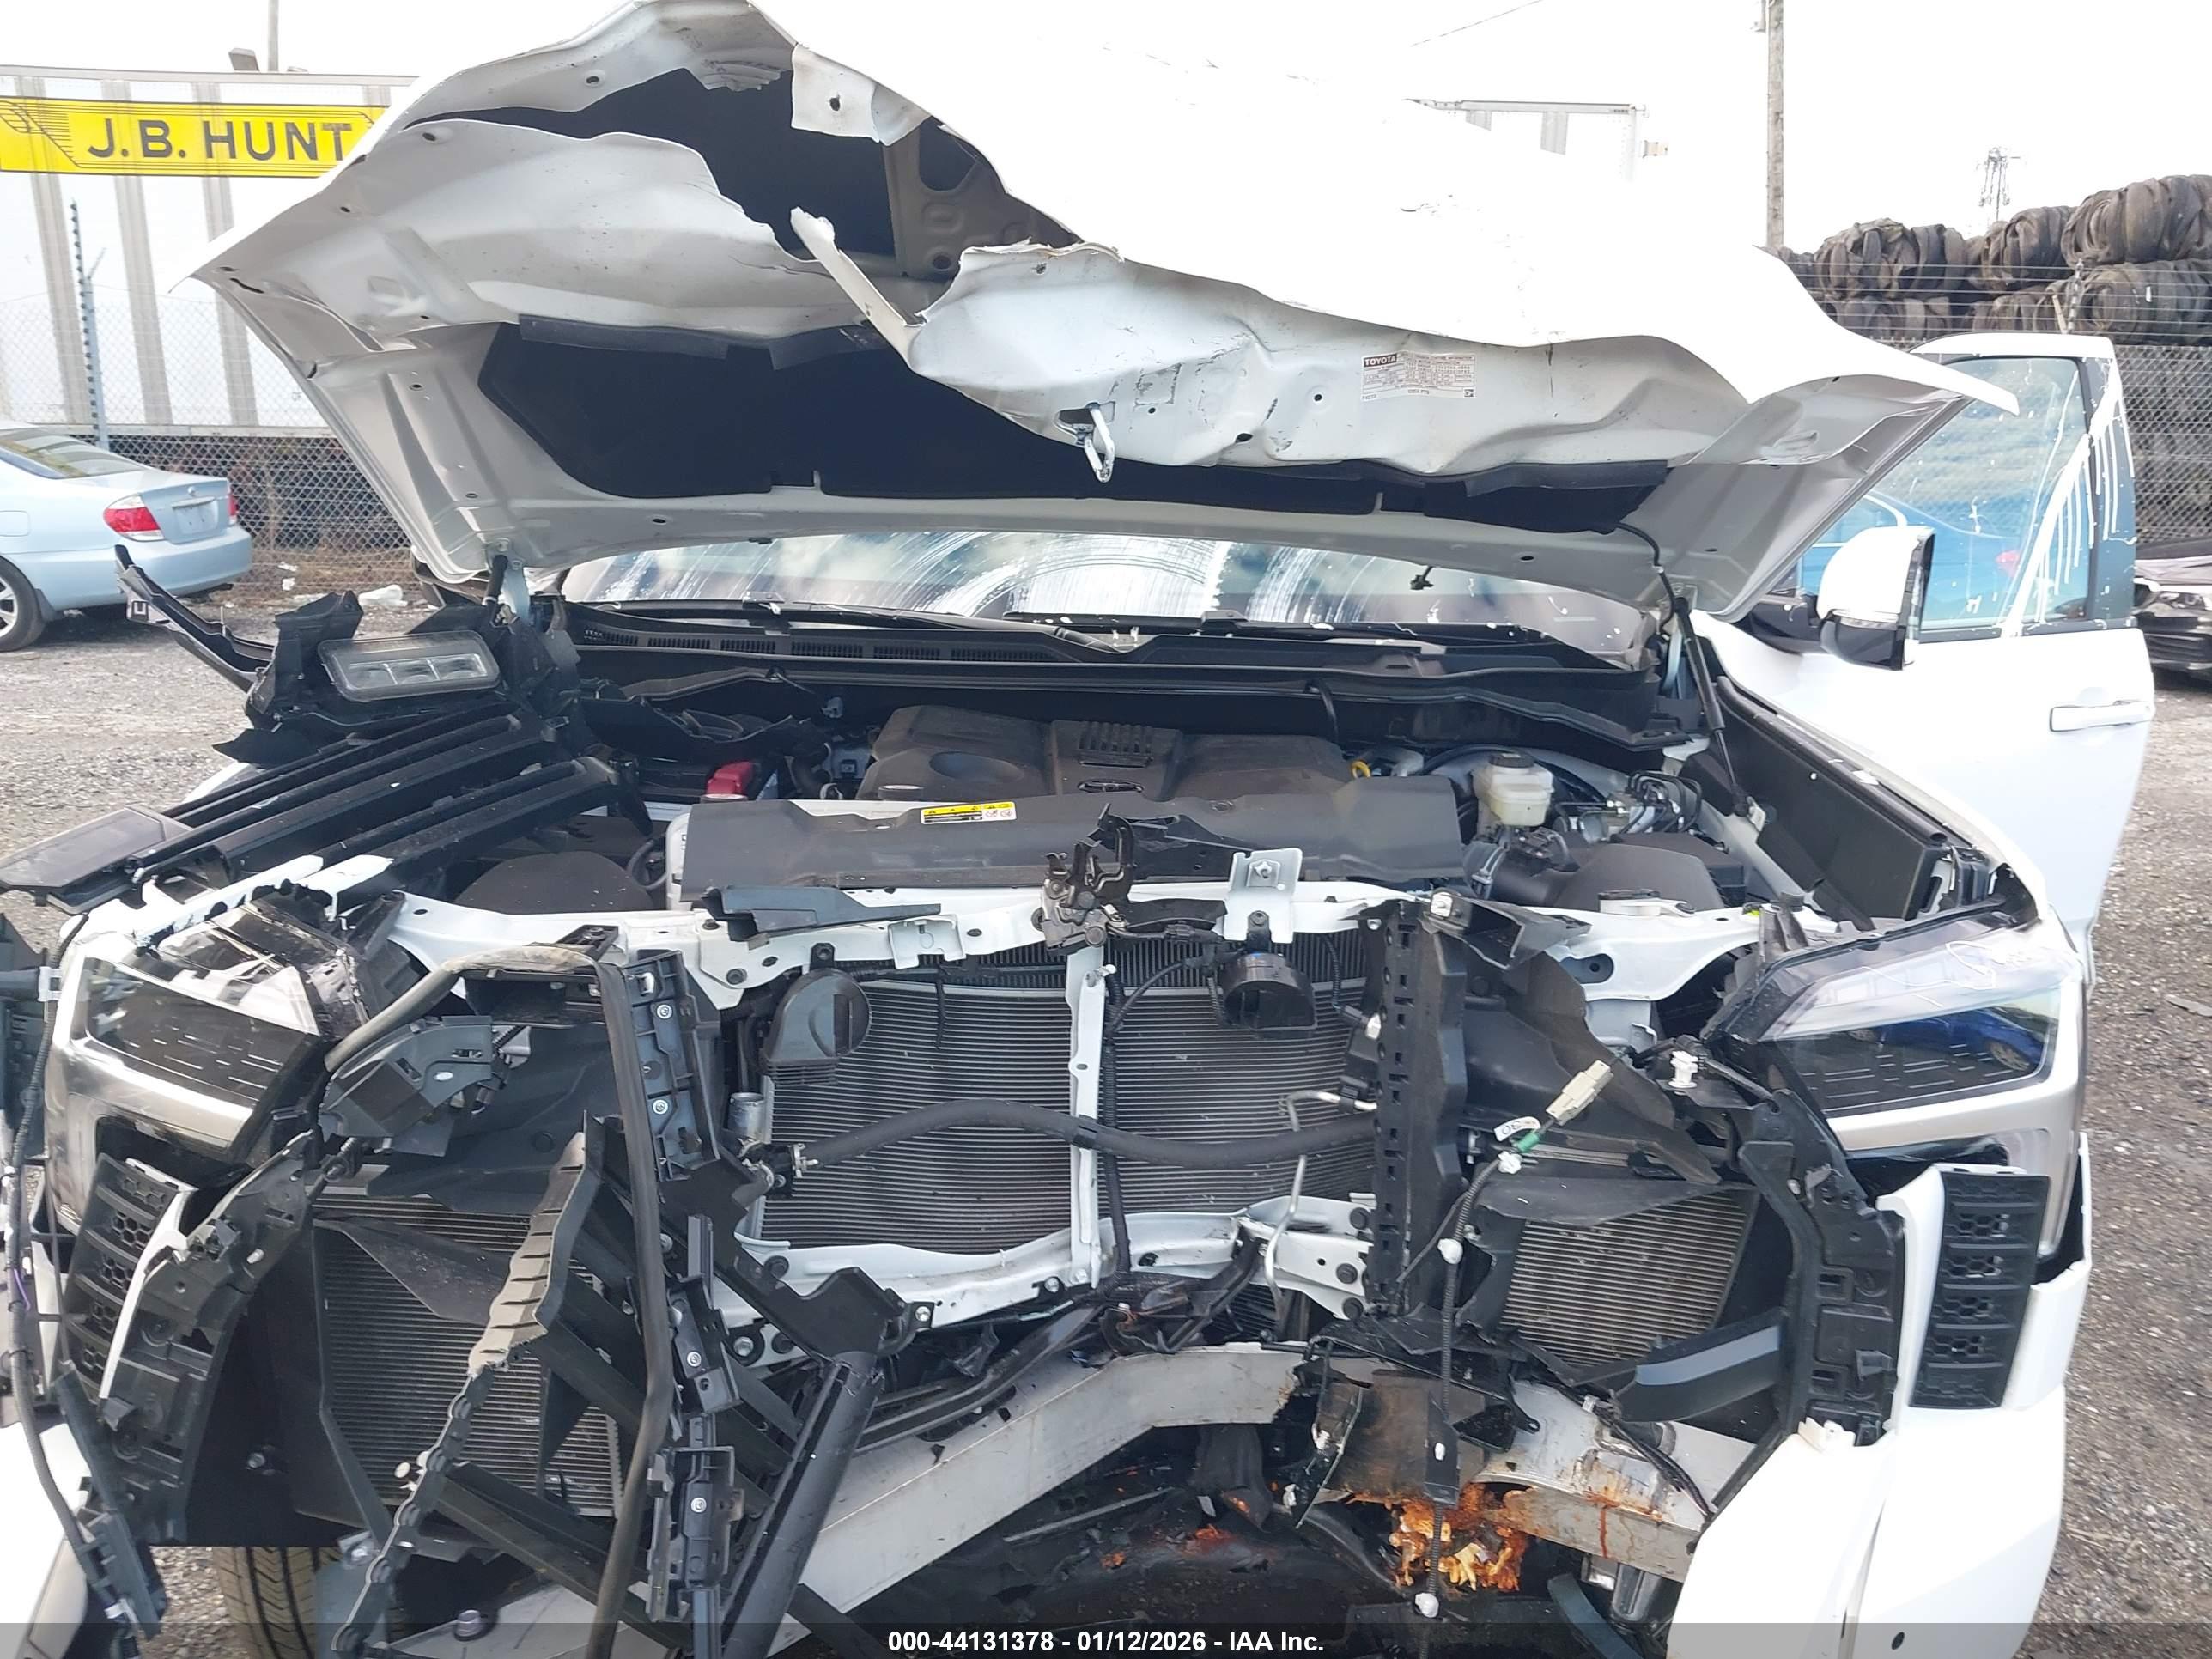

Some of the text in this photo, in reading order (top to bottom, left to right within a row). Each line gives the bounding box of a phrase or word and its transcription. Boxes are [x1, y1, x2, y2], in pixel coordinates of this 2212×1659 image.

[88, 118, 353, 161] J.B. HUNT
[1364, 355, 1397, 366] TOYOTA
